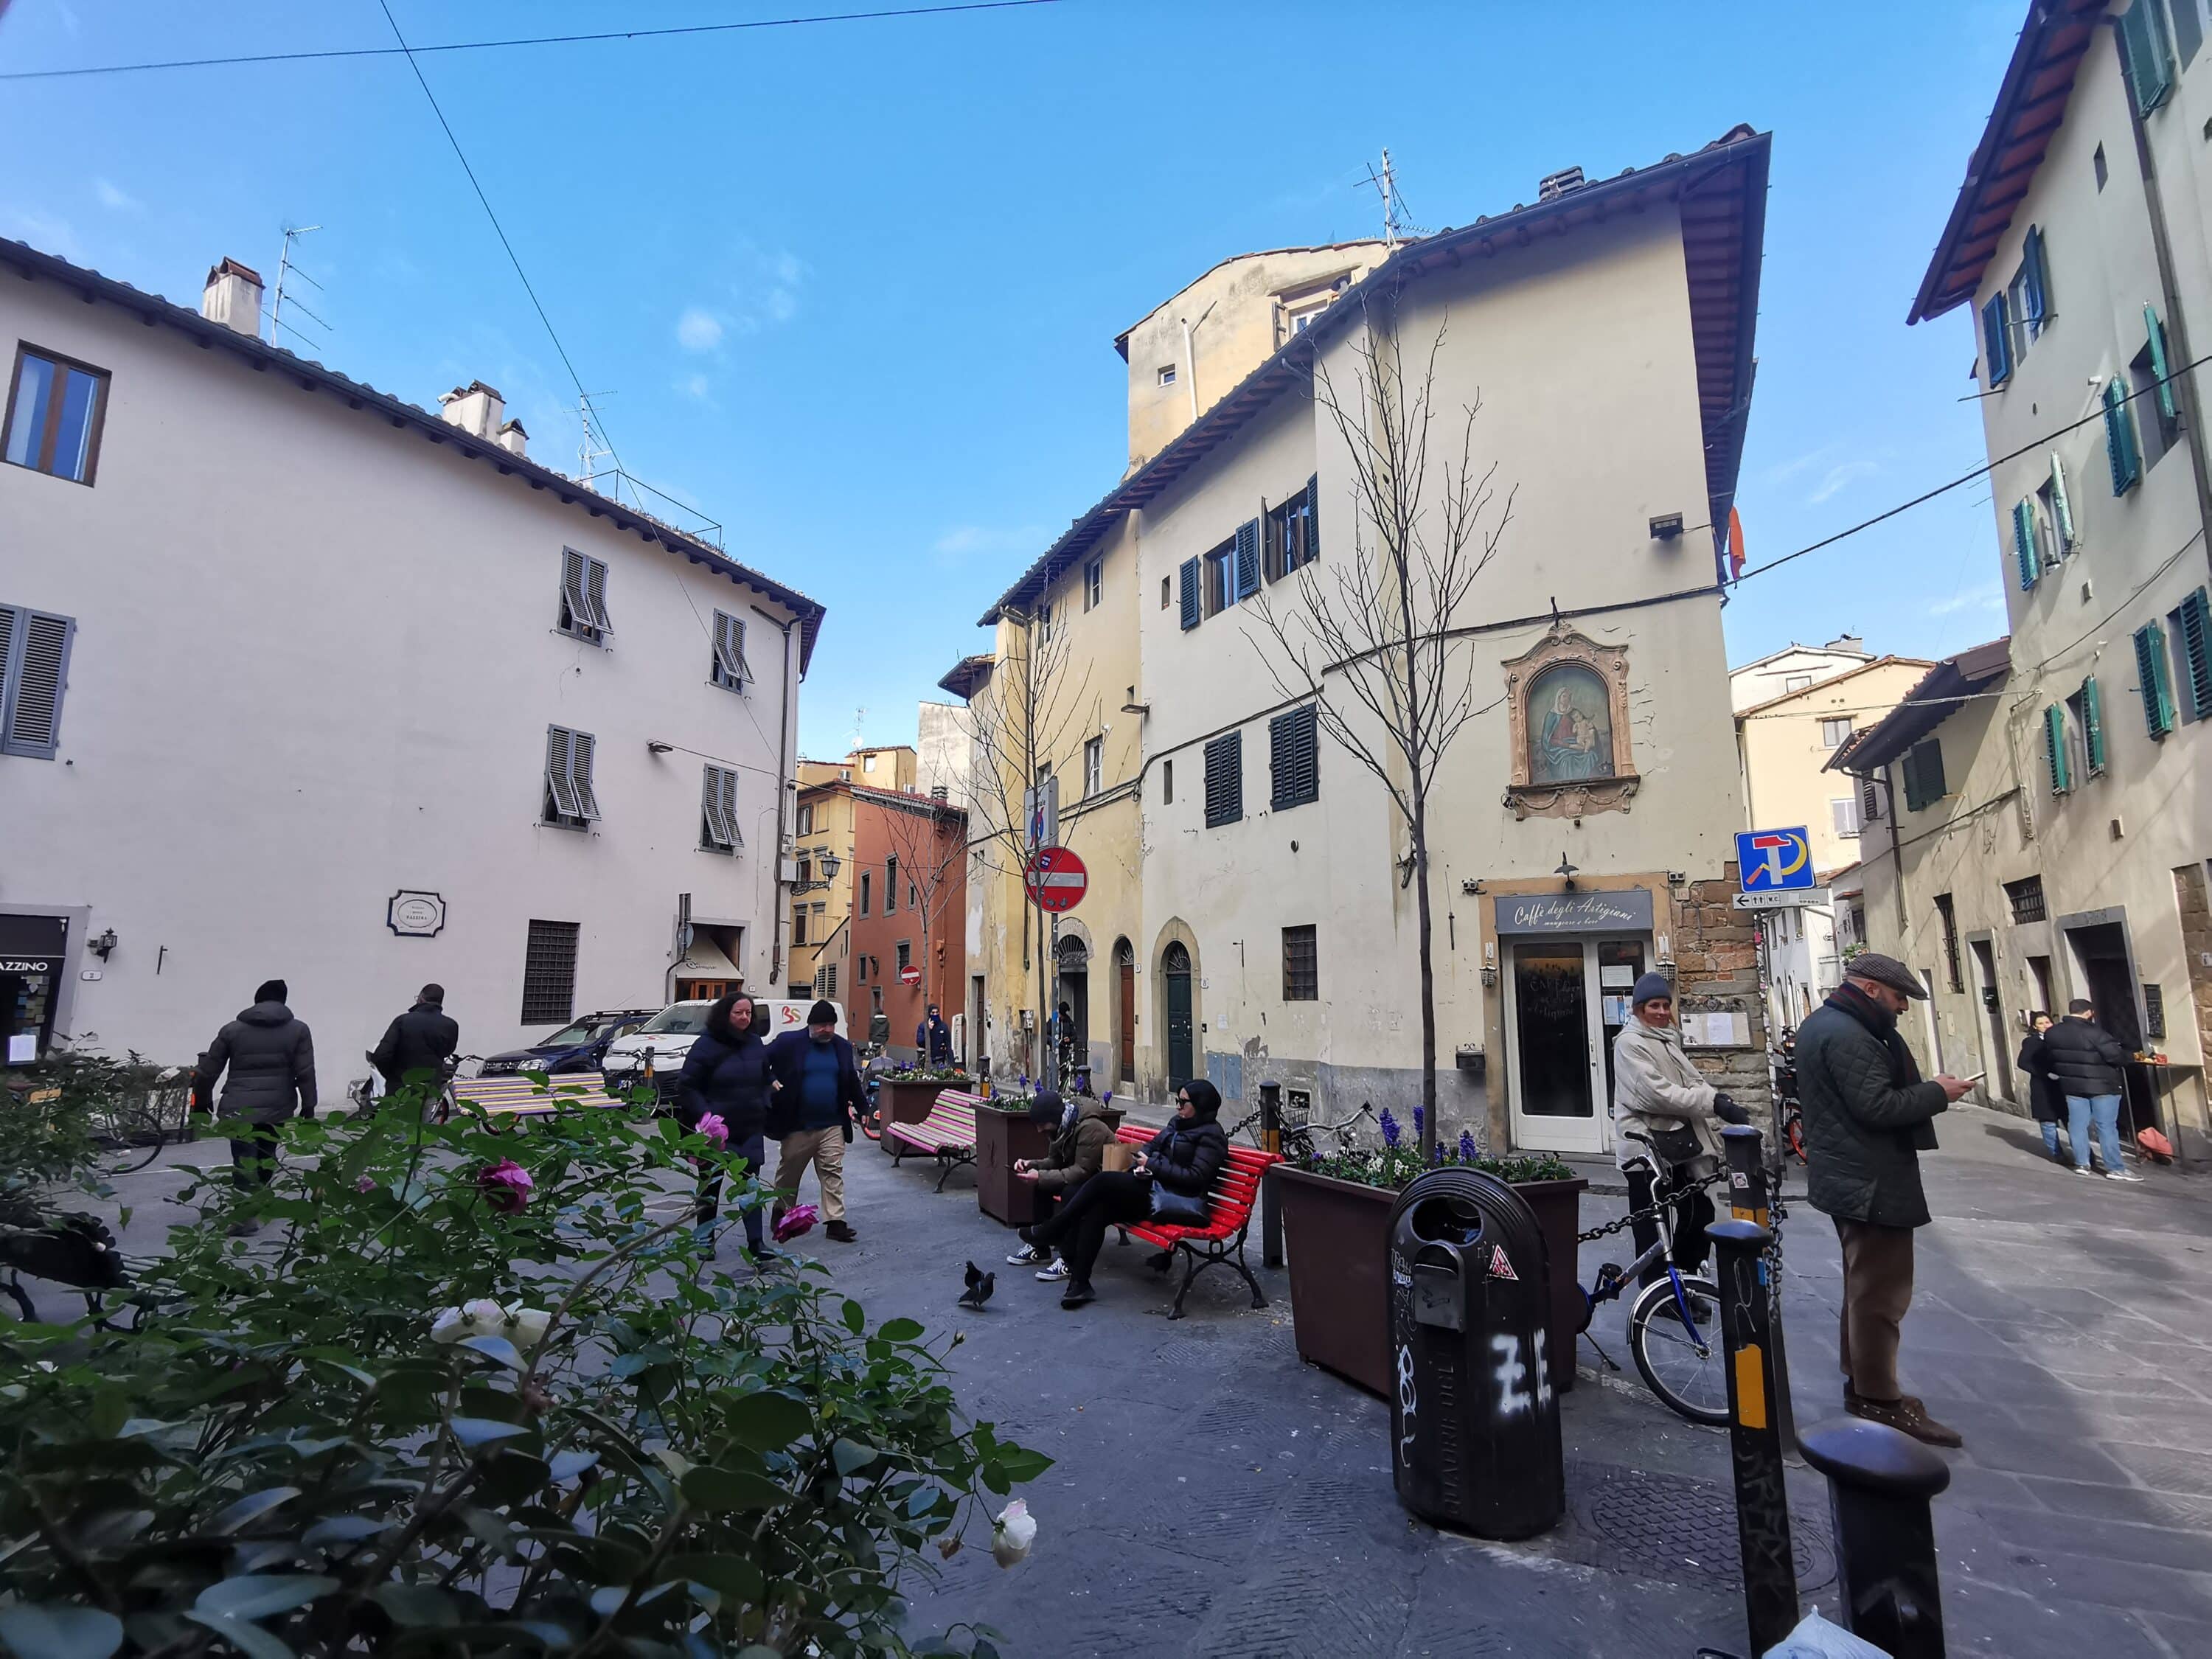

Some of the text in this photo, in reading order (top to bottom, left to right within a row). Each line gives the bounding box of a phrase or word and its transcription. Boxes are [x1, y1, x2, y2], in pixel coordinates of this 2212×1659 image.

[1514, 897, 1636, 927] Caffè degli Artigiani
